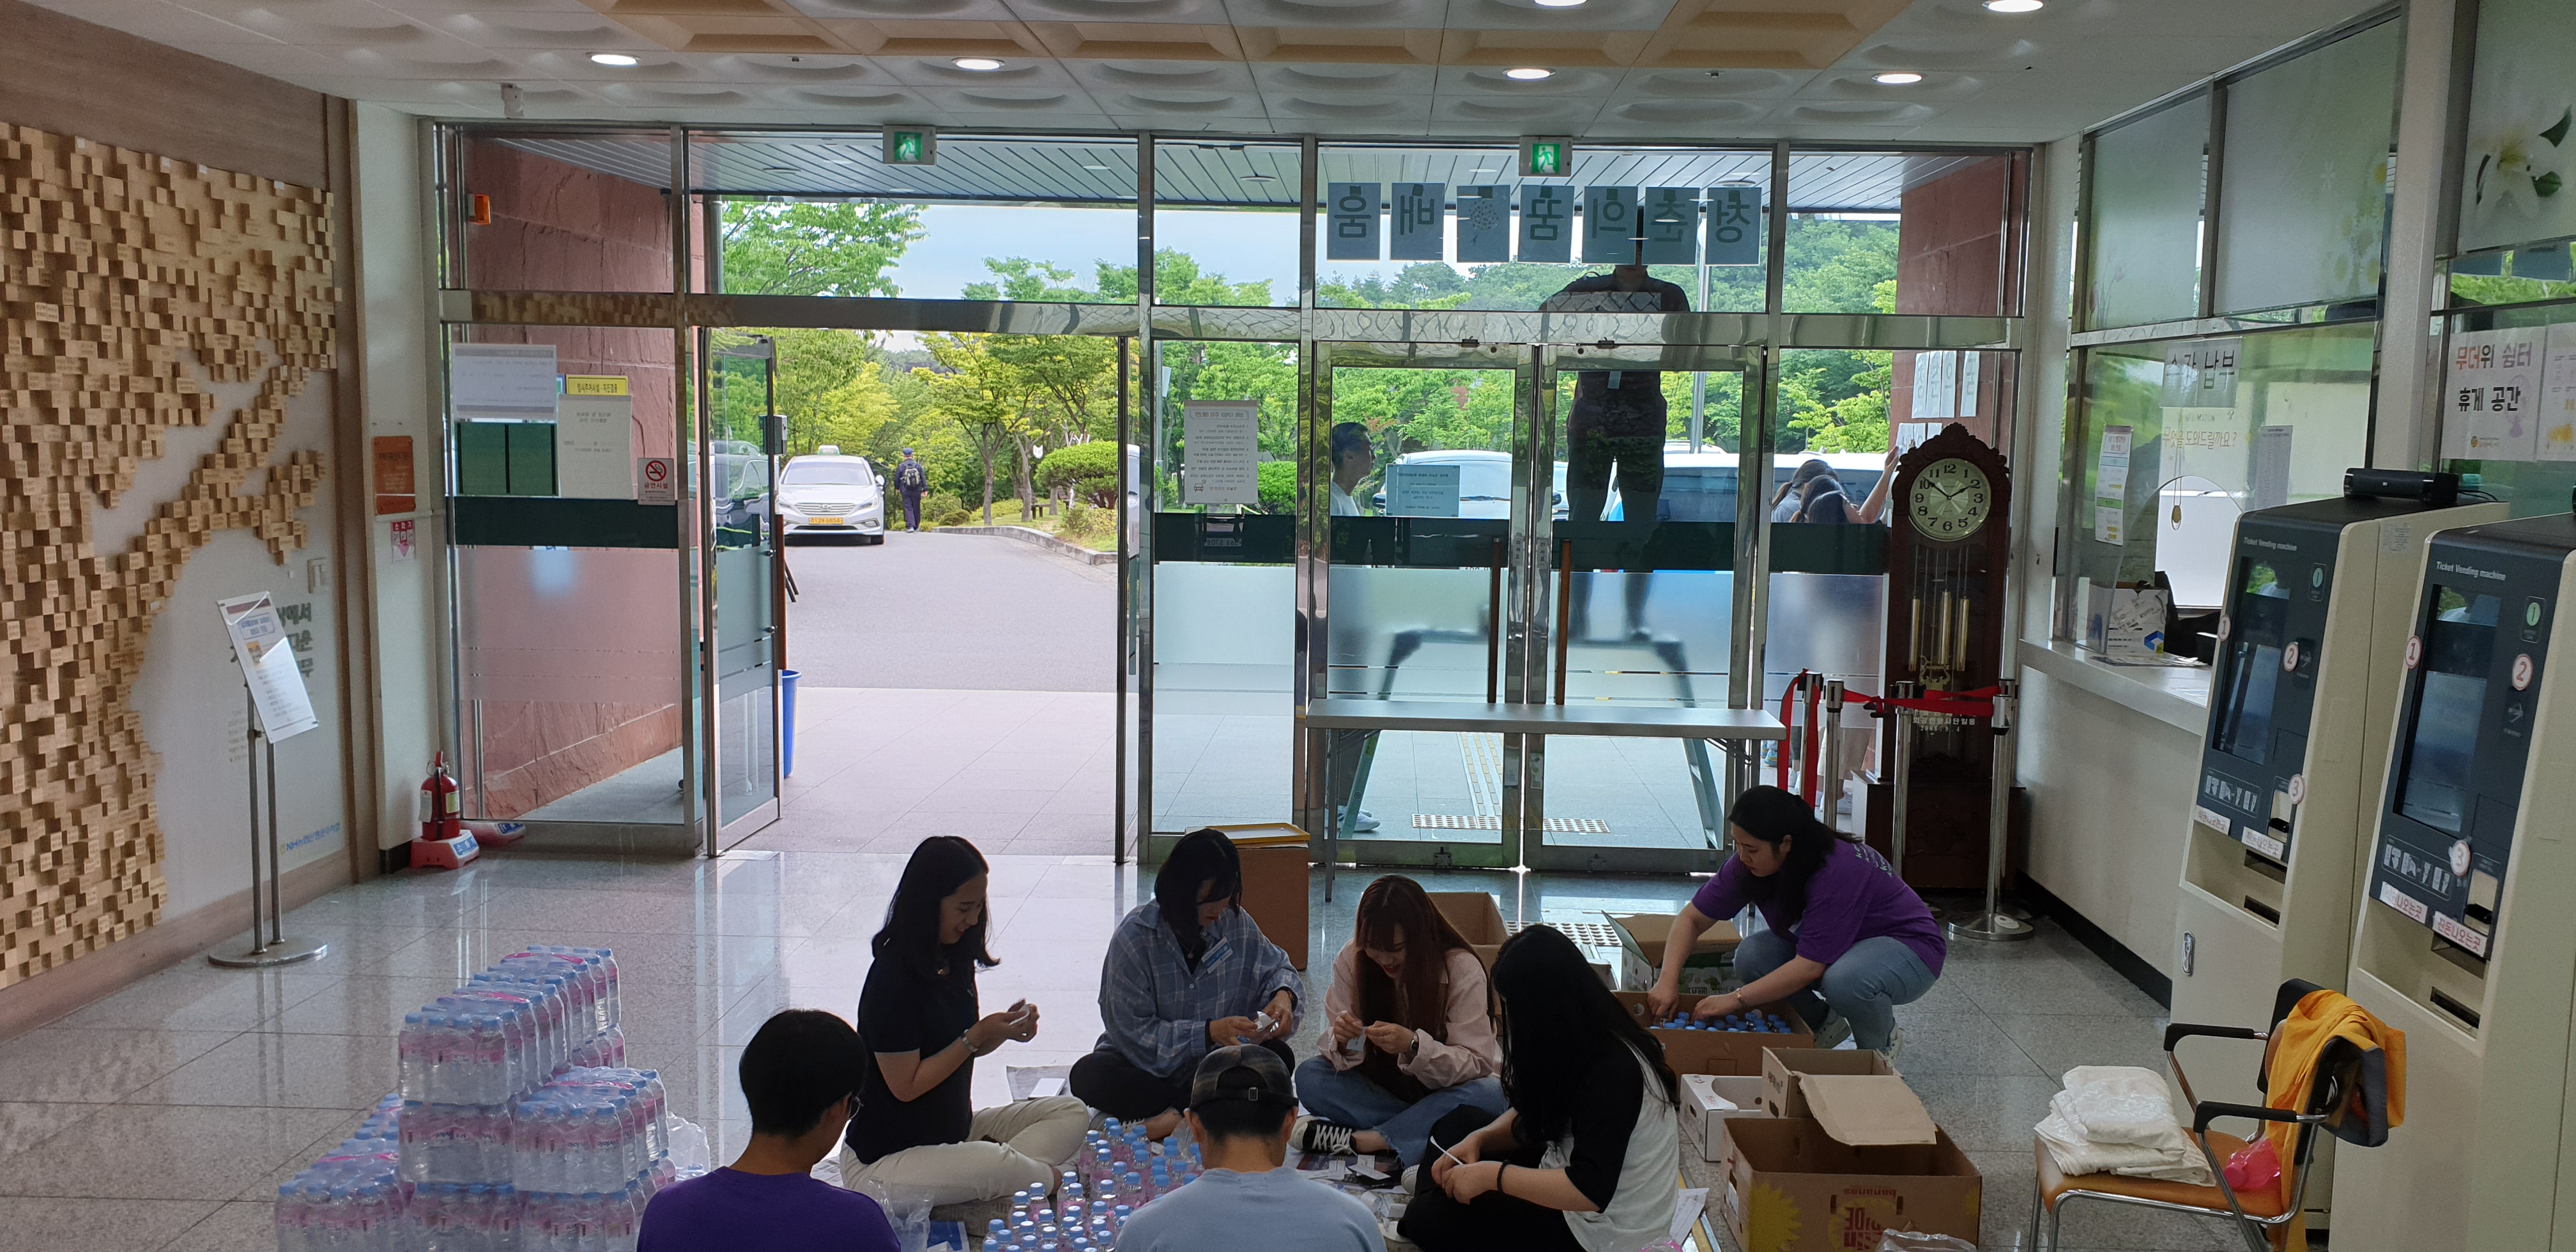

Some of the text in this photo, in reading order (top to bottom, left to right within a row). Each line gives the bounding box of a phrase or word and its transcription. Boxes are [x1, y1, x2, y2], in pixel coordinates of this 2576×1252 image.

[2456, 342, 2532, 370] 무더위 쉼터
[2204, 350, 2235, 390] 납부
[2458, 386, 2521, 412] 휴게 공간
[1929, 468, 1940, 478] 11
[1943, 463, 1957, 474] 12
[1963, 469, 1968, 478] 1
[1919, 480, 1930, 489] 10
[1970, 479, 1981, 489] 2
[1915, 492, 1924, 503] 9
[1974, 492, 1984, 503] 3
[1917, 506, 1928, 516] 8
[1968, 507, 1978, 516] 4
[1928, 517, 1938, 527] 7
[1942, 521, 1953, 531] 6
[1958, 517, 1968, 528] 5
[2244, 537, 2297, 551] Ticket Vending machine
[2436, 561, 2506, 581] Ticket Vending machine
[1844, 1189, 1896, 1198] bananas
